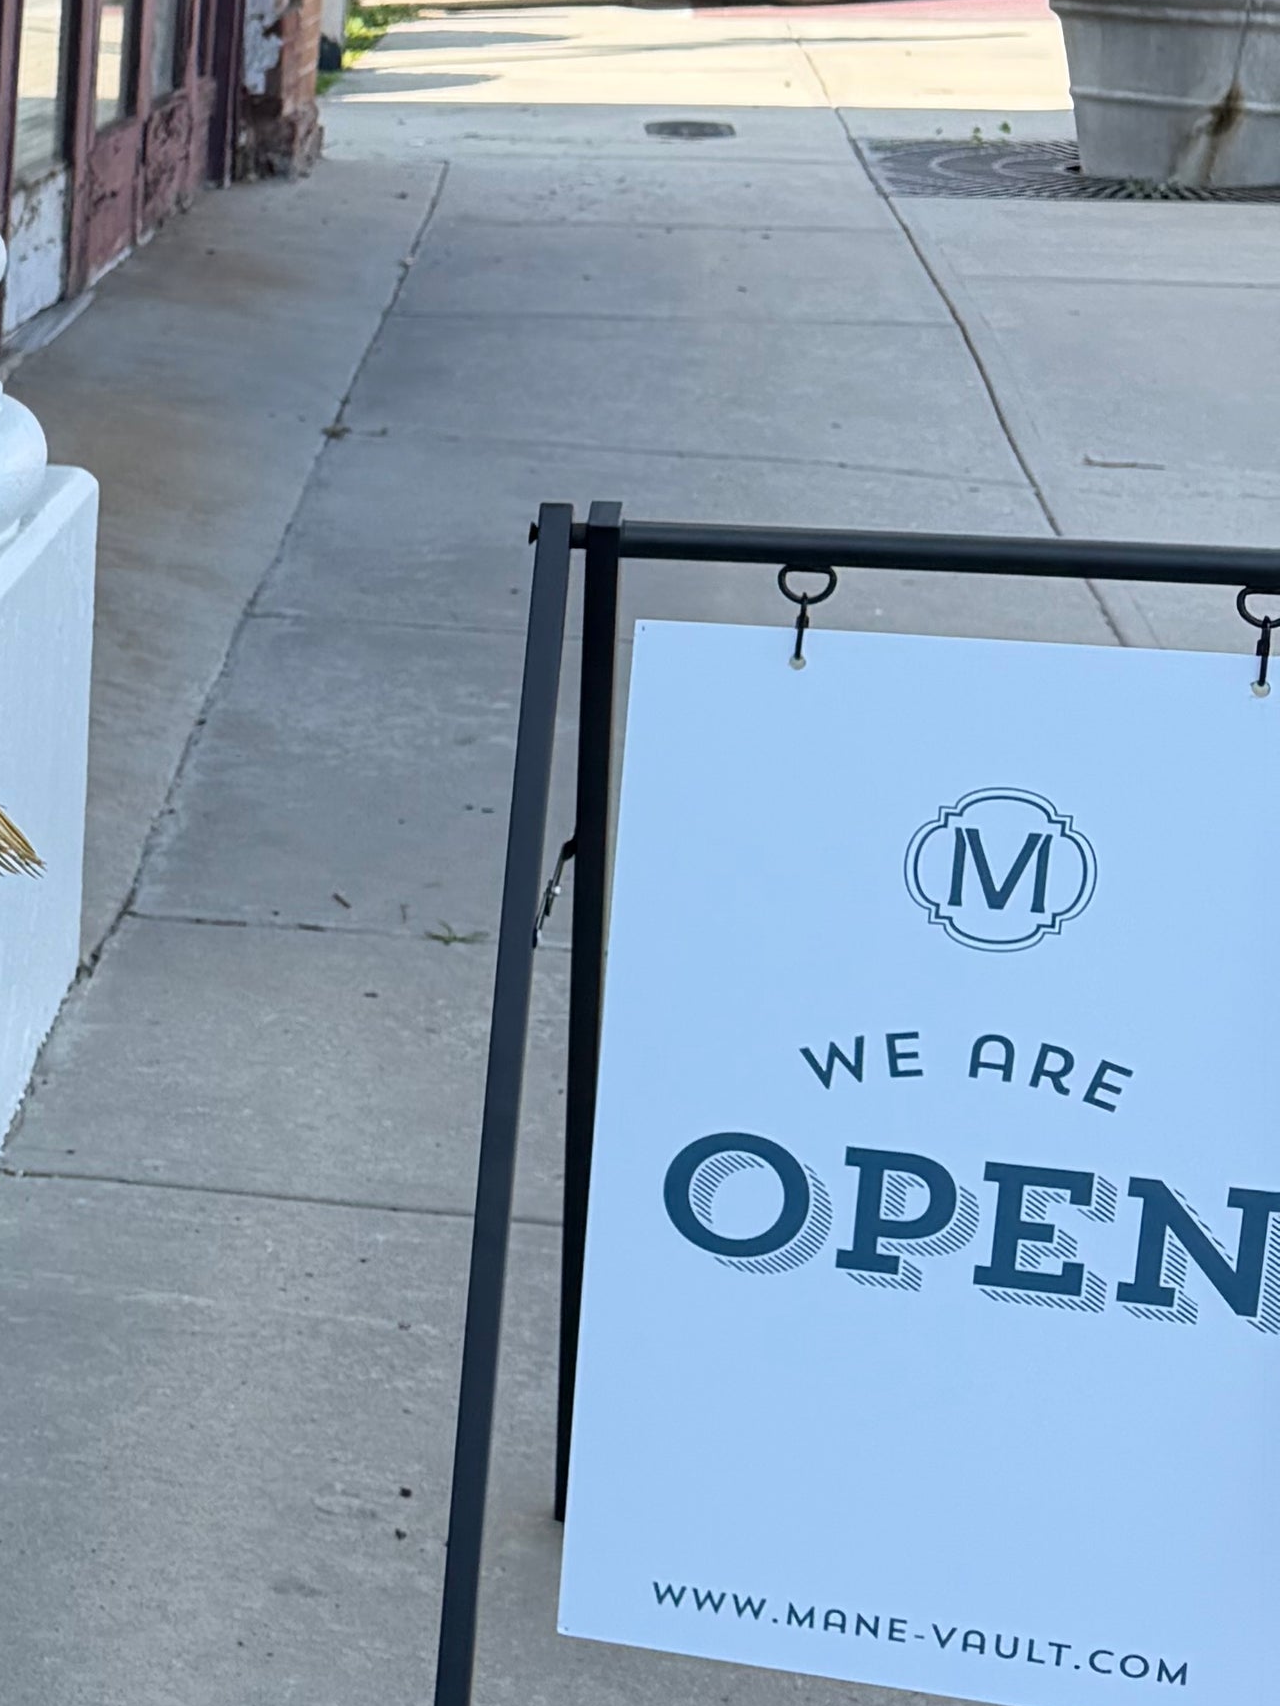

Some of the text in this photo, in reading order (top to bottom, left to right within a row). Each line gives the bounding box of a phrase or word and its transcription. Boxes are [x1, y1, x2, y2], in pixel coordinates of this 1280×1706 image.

[947, 826, 1053, 914] M
[799, 1030, 1134, 1113] WE ARE
[663, 1131, 1280, 1334] OPEN
[652, 1580, 1190, 1687] WWW.MANE-VAULT.COM
